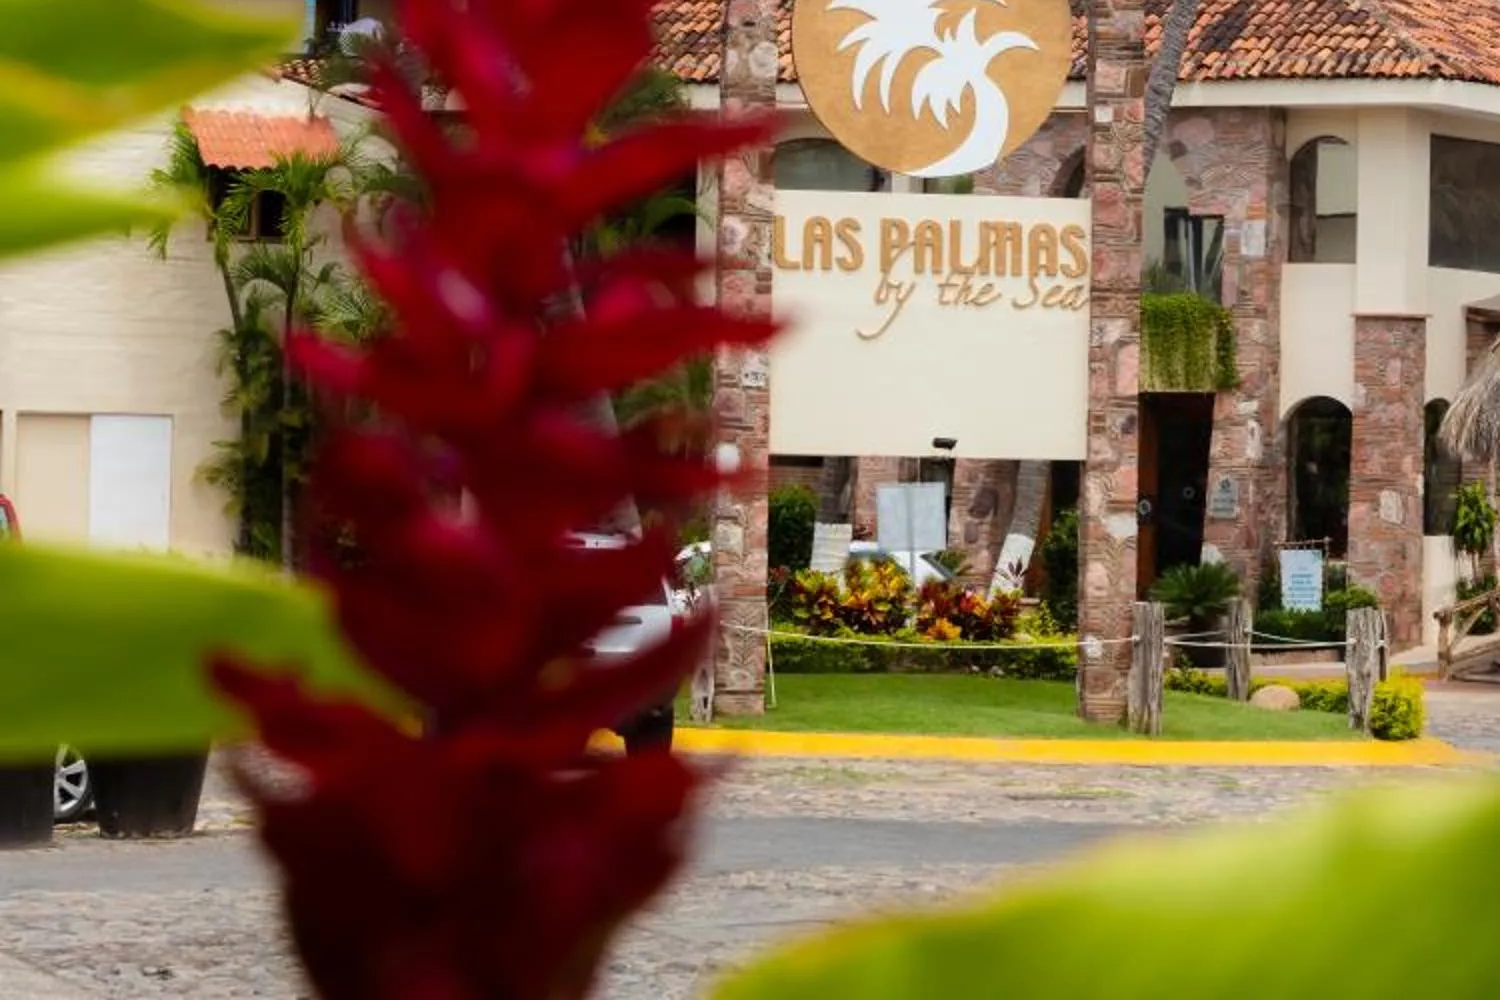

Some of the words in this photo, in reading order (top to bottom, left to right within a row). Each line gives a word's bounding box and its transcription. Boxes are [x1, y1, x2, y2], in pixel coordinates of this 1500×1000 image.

[773, 215, 864, 272] LAS
[879, 217, 1089, 279] PALMAS
[856, 241, 917, 341] by
[937, 264, 1002, 307] the
[1011, 268, 1089, 311] Sea
